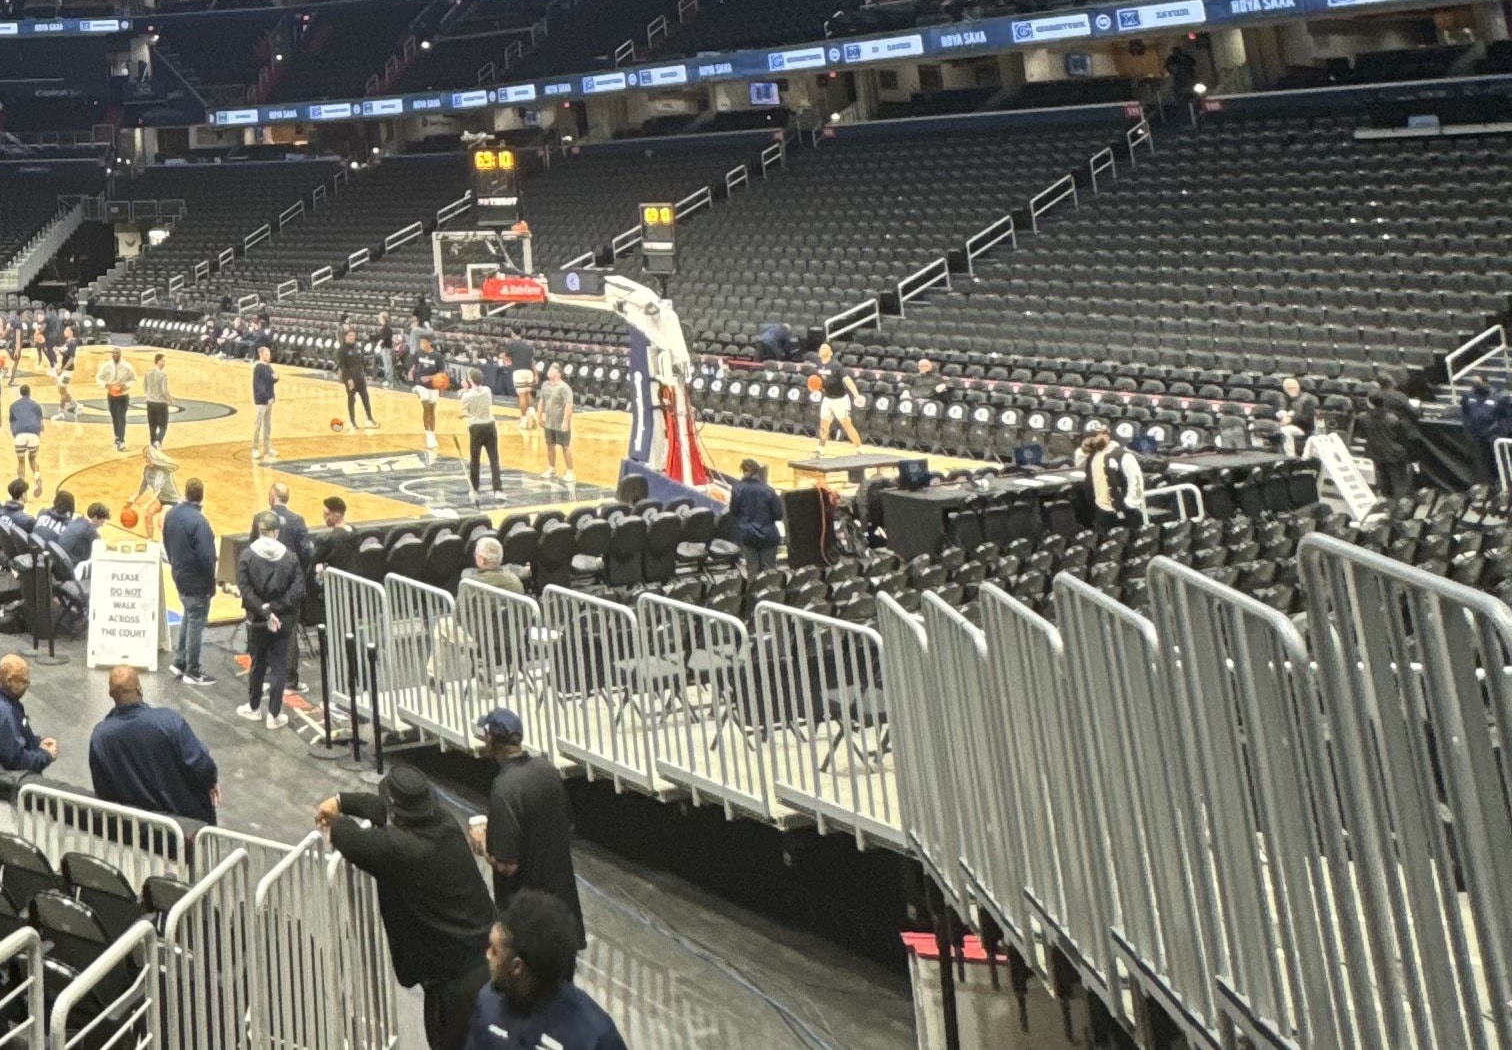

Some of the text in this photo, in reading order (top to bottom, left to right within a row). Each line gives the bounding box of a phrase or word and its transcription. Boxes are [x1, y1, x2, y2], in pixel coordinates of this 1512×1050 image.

[474, 150, 514, 170] 69:10
[111, 573, 139, 582] PLEASE
[110, 588, 142, 598] DO NOT
[113, 601, 136, 609] WALK
[108, 615, 140, 623] ACROSS
[101, 628, 146, 638] THE COURT
